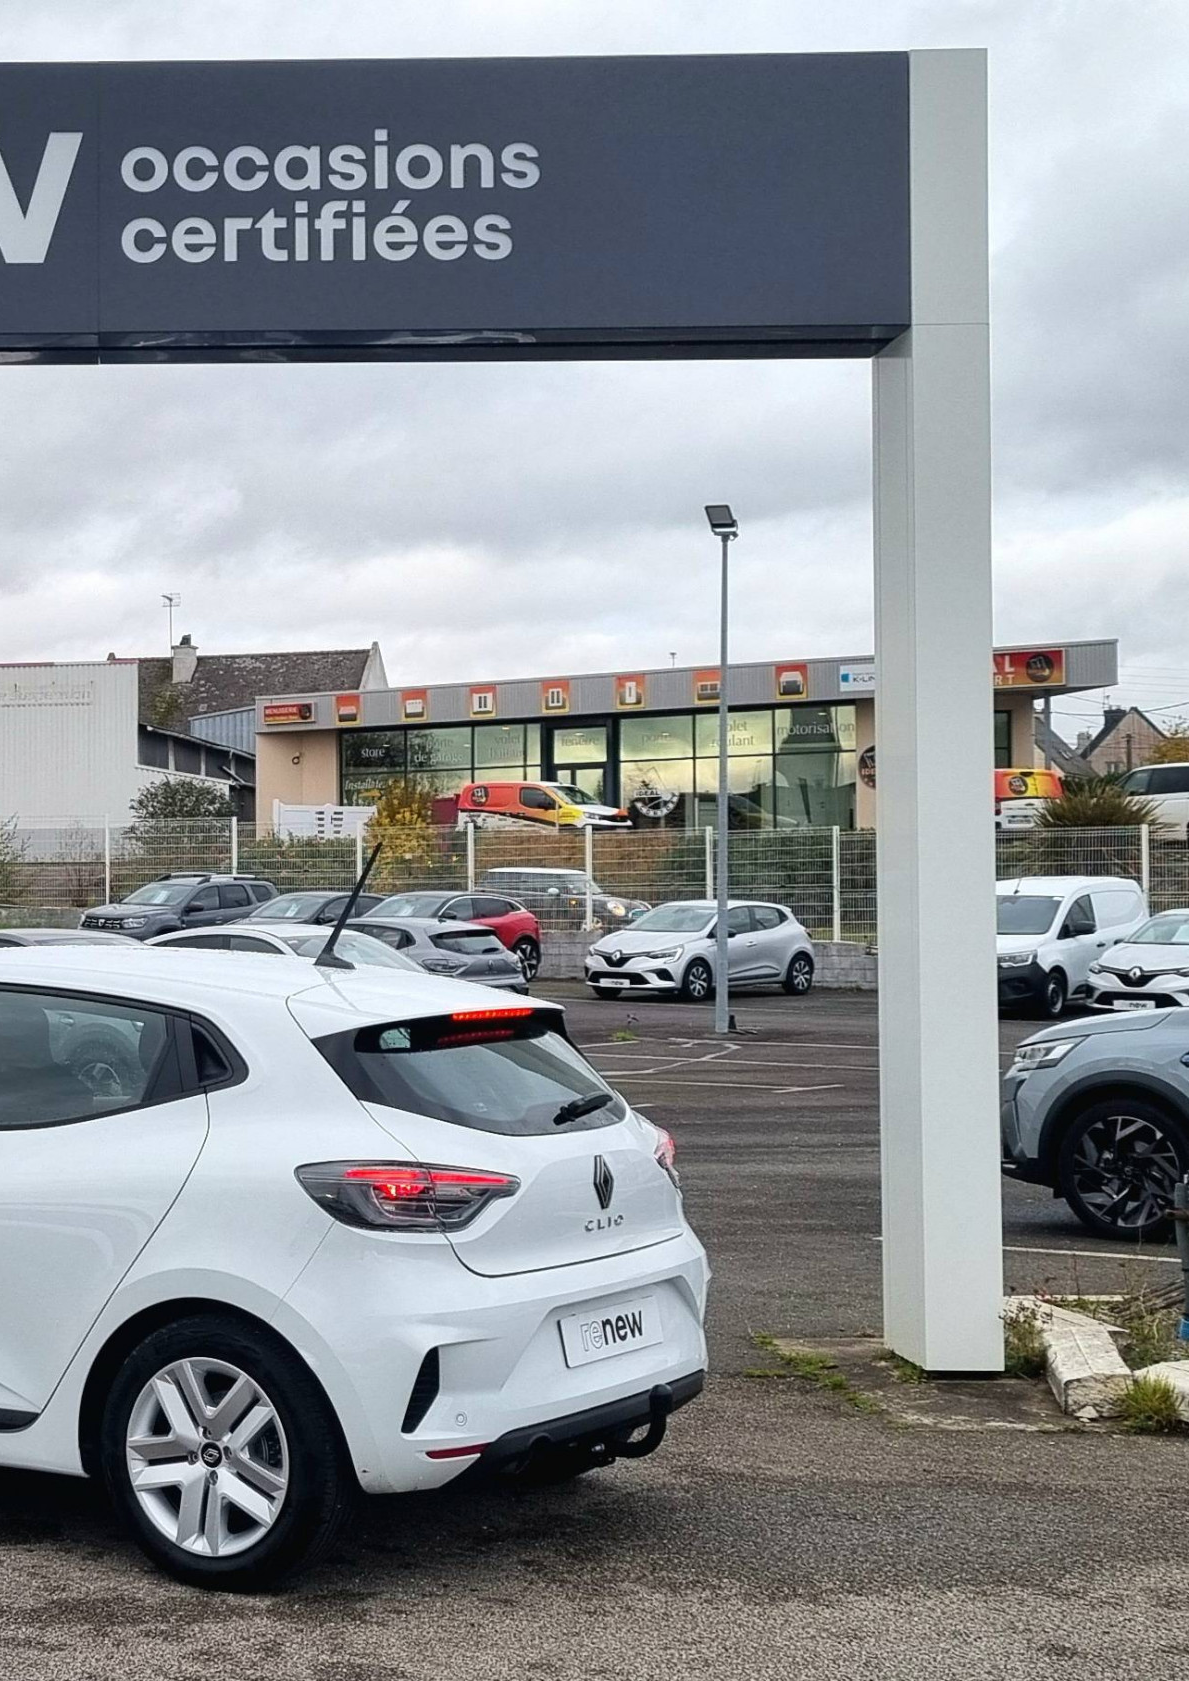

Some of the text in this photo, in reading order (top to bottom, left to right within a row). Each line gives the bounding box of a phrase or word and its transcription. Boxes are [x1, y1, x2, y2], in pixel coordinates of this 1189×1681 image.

[121, 128, 541, 192] occasions
[121, 200, 513, 263] certifiées
[777, 721, 855, 736] motorisaton
[712, 734, 755, 748] rulant
[361, 748, 386, 758] store
[413, 751, 463, 765] de garage
[584, 1214, 624, 1232] CLIO
[580, 1310, 643, 1352] renew
